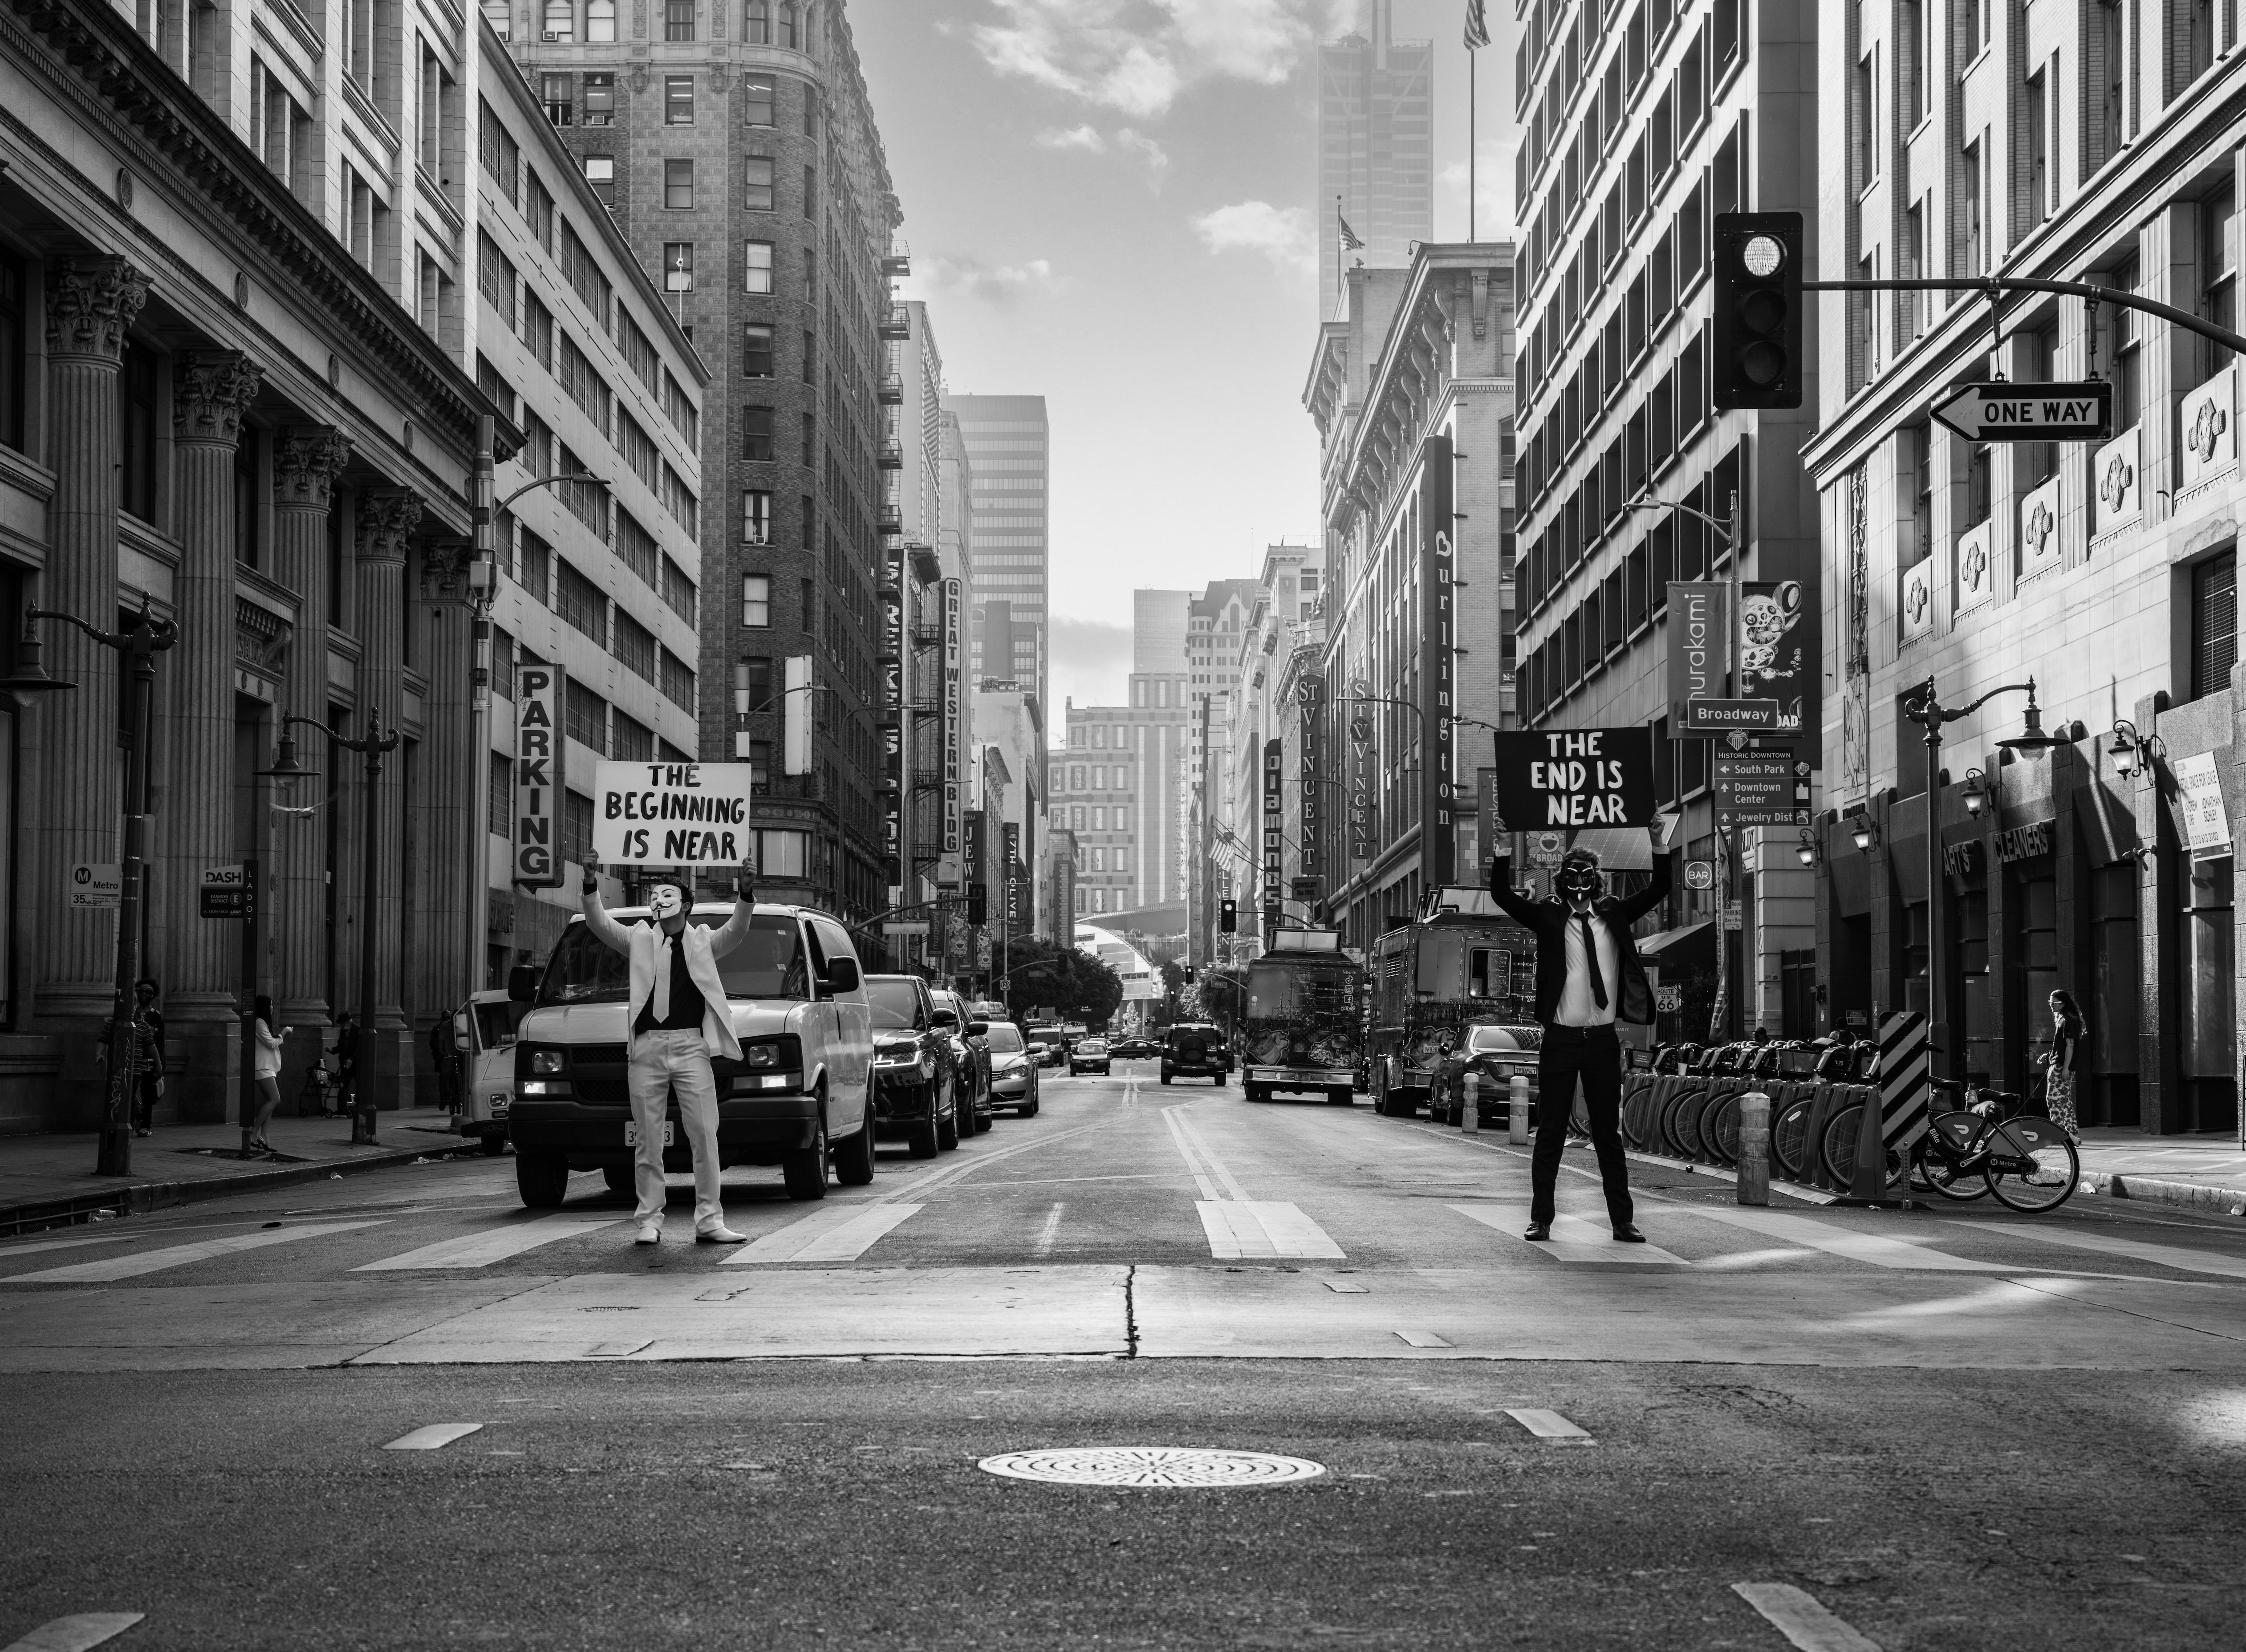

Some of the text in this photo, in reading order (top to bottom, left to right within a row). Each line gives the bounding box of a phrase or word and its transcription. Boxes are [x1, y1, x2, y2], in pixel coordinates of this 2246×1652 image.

[1985, 402, 2093, 423] ONE WAY
[1435, 530, 1452, 825] Burlington
[1299, 681, 1318, 702] ST
[1354, 683, 1367, 717] ST
[946, 581, 959, 849] GREAT WESTERN BLDG
[1698, 708, 1769, 723] Broadway
[1546, 731, 1603, 757] THE
[519, 671, 552, 875] PARKING
[647, 764, 702, 788] THE
[1531, 760, 1623, 791] END IS
[1734, 765, 1785, 774] South Park
[1301, 708, 1316, 865] VINCENT
[1734, 783, 1781, 791] Downtown
[2189, 775, 2200, 790] SPACE
[2198, 773, 2207, 787] FOR
[2205, 770, 2217, 785] LEASE
[605, 791, 745, 824] BEGINNING
[1352, 743, 1369, 856] VINCENT
[1735, 795, 1766, 804] Center
[2201, 795, 2222, 810] JONATHAN
[1547, 794, 1628, 825] NEAR
[1735, 812, 1793, 824] Jewelry Dist
[2203, 809, 2218, 823] SCHLEY
[622, 828, 737, 861] IS NEAR
[2208, 832, 2219, 842] 3103
[1536, 853, 1563, 862] BROAD
[1943, 822, 2048, 876] ART'S CLEANERS
[205, 872, 241, 883] DASH
[1689, 871, 1709, 880] BAR
[93, 881, 118, 889] Metro
[1294, 882, 1318, 890] JEWELRY
[73, 894, 85, 904] 35
[1658, 999, 1674, 1010] 66
[1929, 1128, 1940, 1143] Bike
